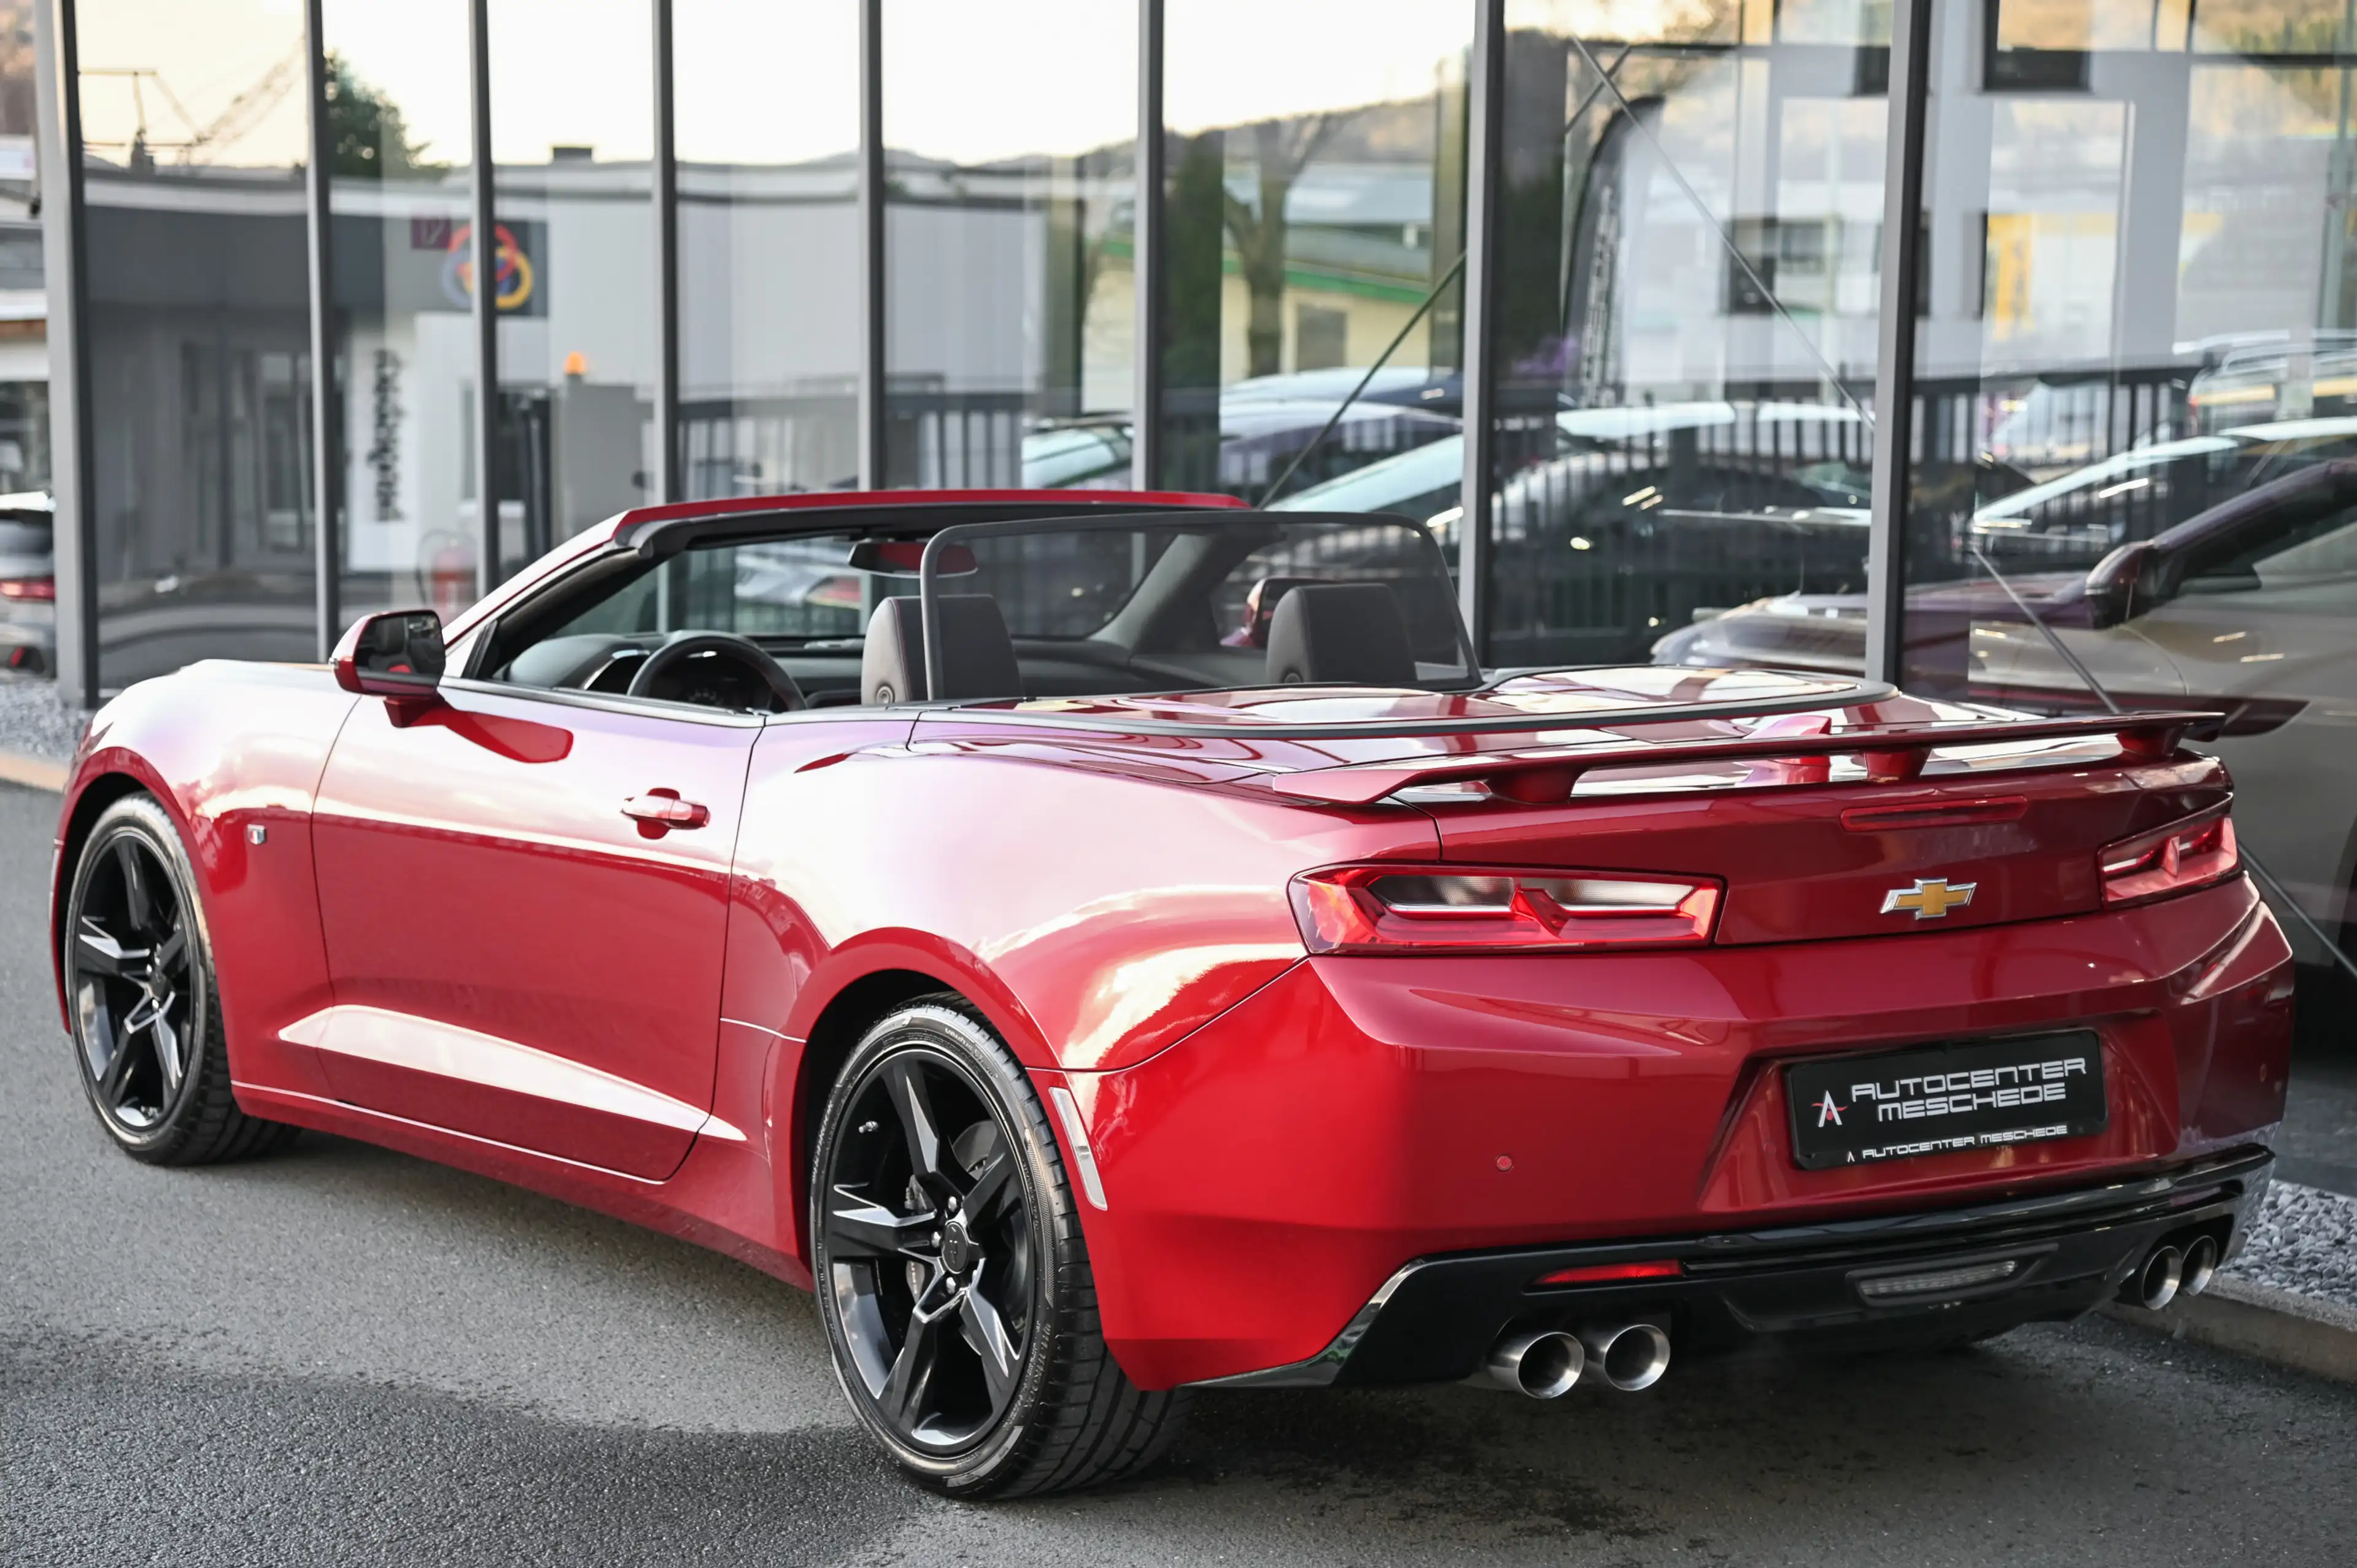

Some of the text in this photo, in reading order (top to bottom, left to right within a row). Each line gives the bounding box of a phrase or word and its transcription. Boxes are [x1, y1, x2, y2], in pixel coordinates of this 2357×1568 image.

[1851, 1057, 2086, 1102] AUTOCENTER
[1877, 1082, 2066, 1122] MESCHEDE
[1862, 1136, 1975, 1159] AUTOCENTER
[1980, 1125, 2068, 1144] MESCHEDE
